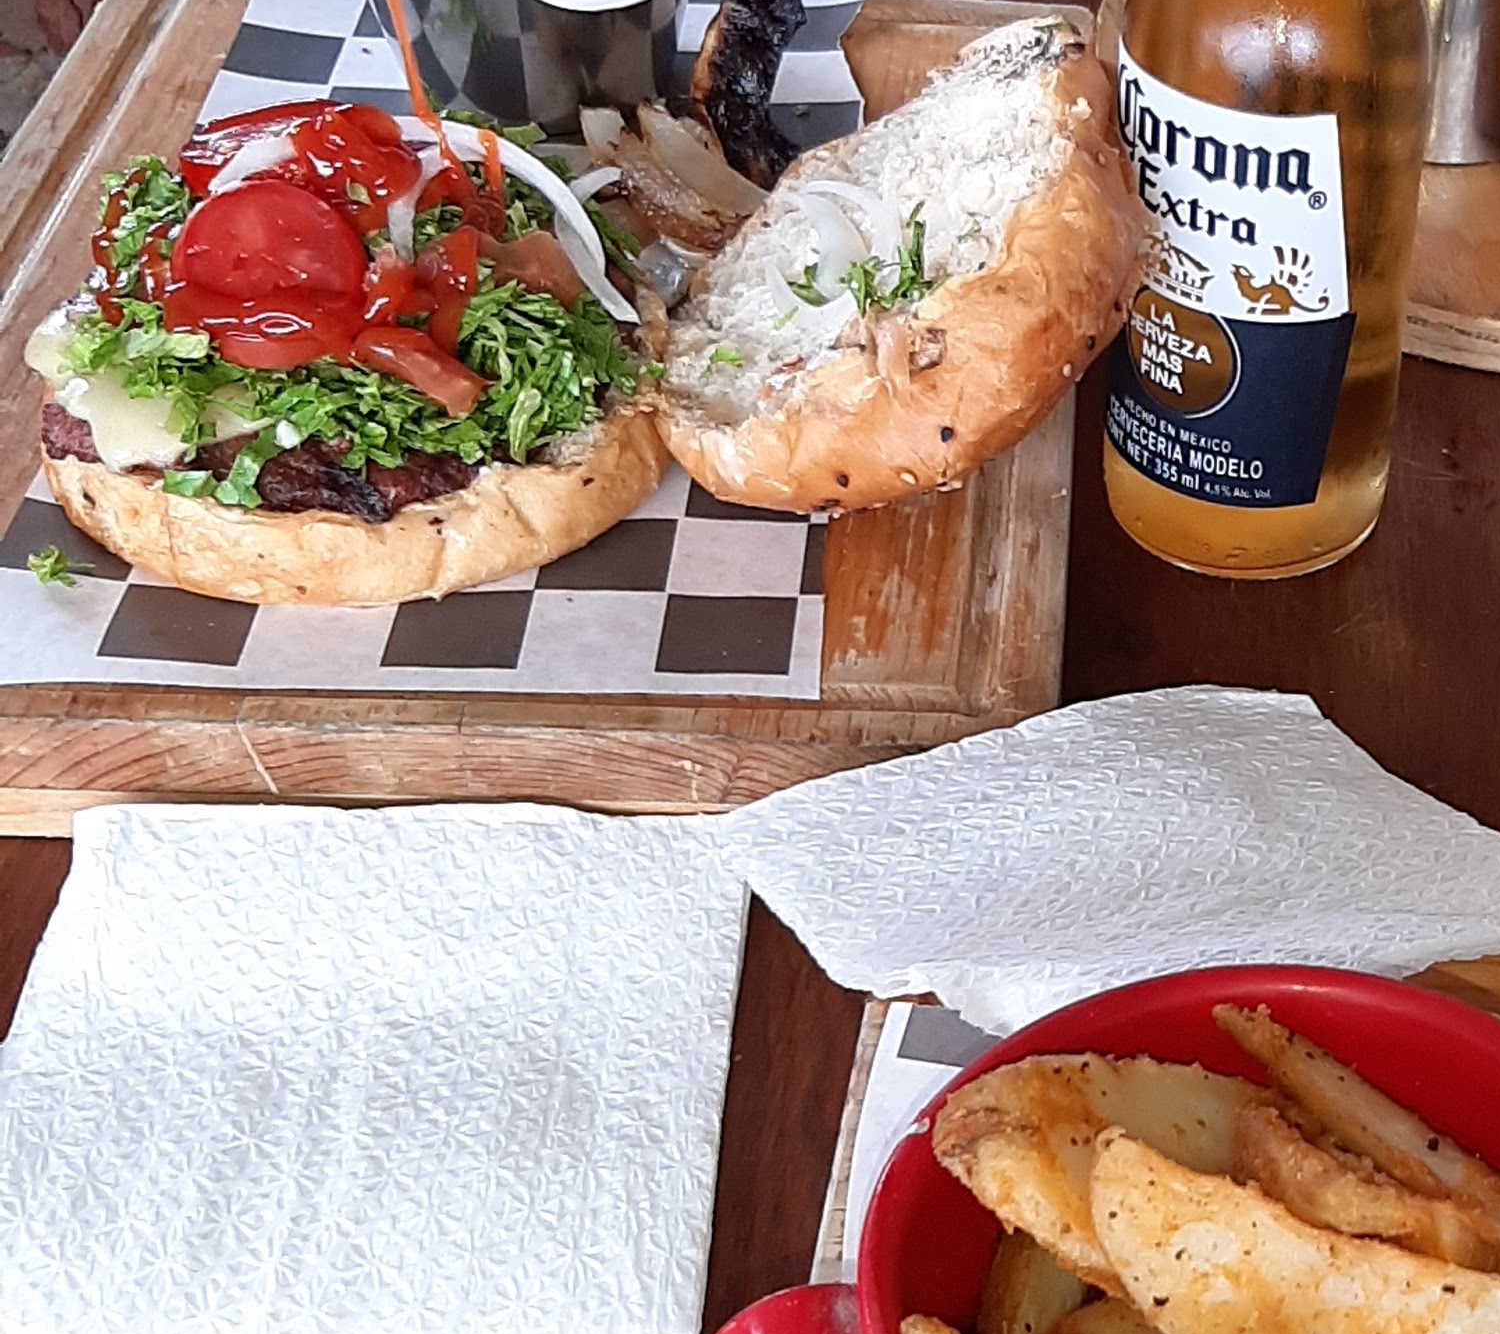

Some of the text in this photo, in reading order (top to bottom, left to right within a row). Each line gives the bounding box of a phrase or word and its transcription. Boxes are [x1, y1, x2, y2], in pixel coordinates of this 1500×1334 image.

[1118, 63, 1313, 195] Corona
[1138, 155, 1258, 246] Extra
[1150, 303, 1176, 332] LA
[1142, 339, 1183, 374] MAS
[1140, 360, 1183, 395] FINA
[1159, 419, 1176, 438] EN
[1153, 457, 1179, 483] 355
[1181, 473, 1200, 490] ml
[1188, 450, 1263, 480] MODELO
